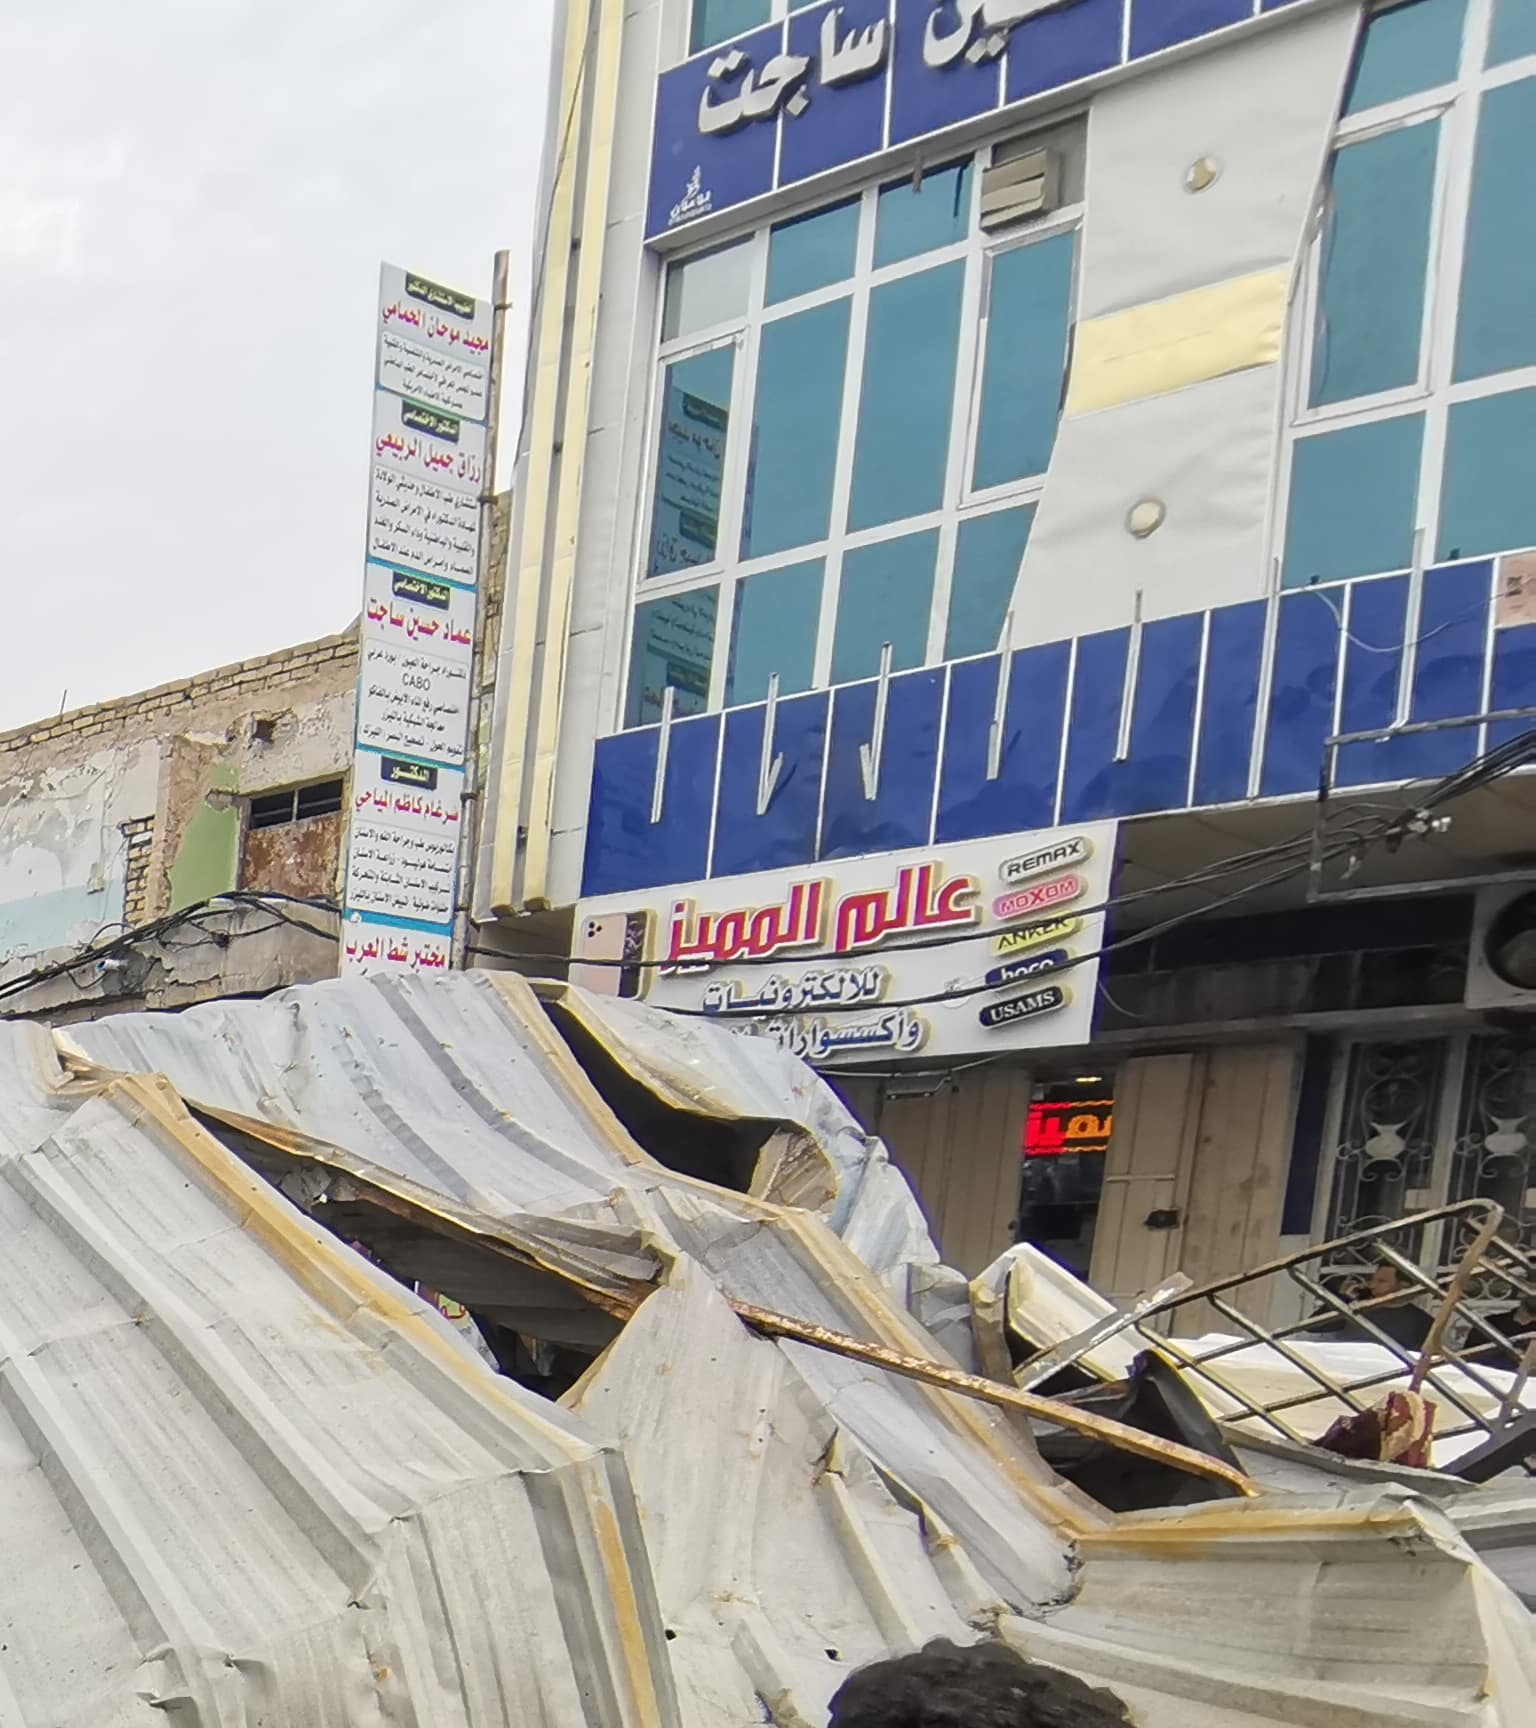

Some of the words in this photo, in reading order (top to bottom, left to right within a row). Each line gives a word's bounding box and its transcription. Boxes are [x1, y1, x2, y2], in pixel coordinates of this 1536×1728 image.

[698, 6, 890, 134] ساجت
[375, 431, 423, 461] الربيعي
[423, 443, 455, 474] جميل
[366, 597, 406, 631] ساجت
[406, 606, 440, 641] حسين
[442, 619, 472, 646] عماد
[401, 672, 432, 692] CABO
[394, 793, 424, 816] كاظم
[1006, 839, 1082, 878] REMAX
[835, 864, 976, 953] عالم
[1000, 879, 1075, 914] MOXOM
[658, 877, 824, 968] المميز
[345, 935, 385, 964] العرب
[387, 934, 410, 963] شط
[409, 943, 446, 973] مختبر
[989, 989, 1056, 1023] USAMS
